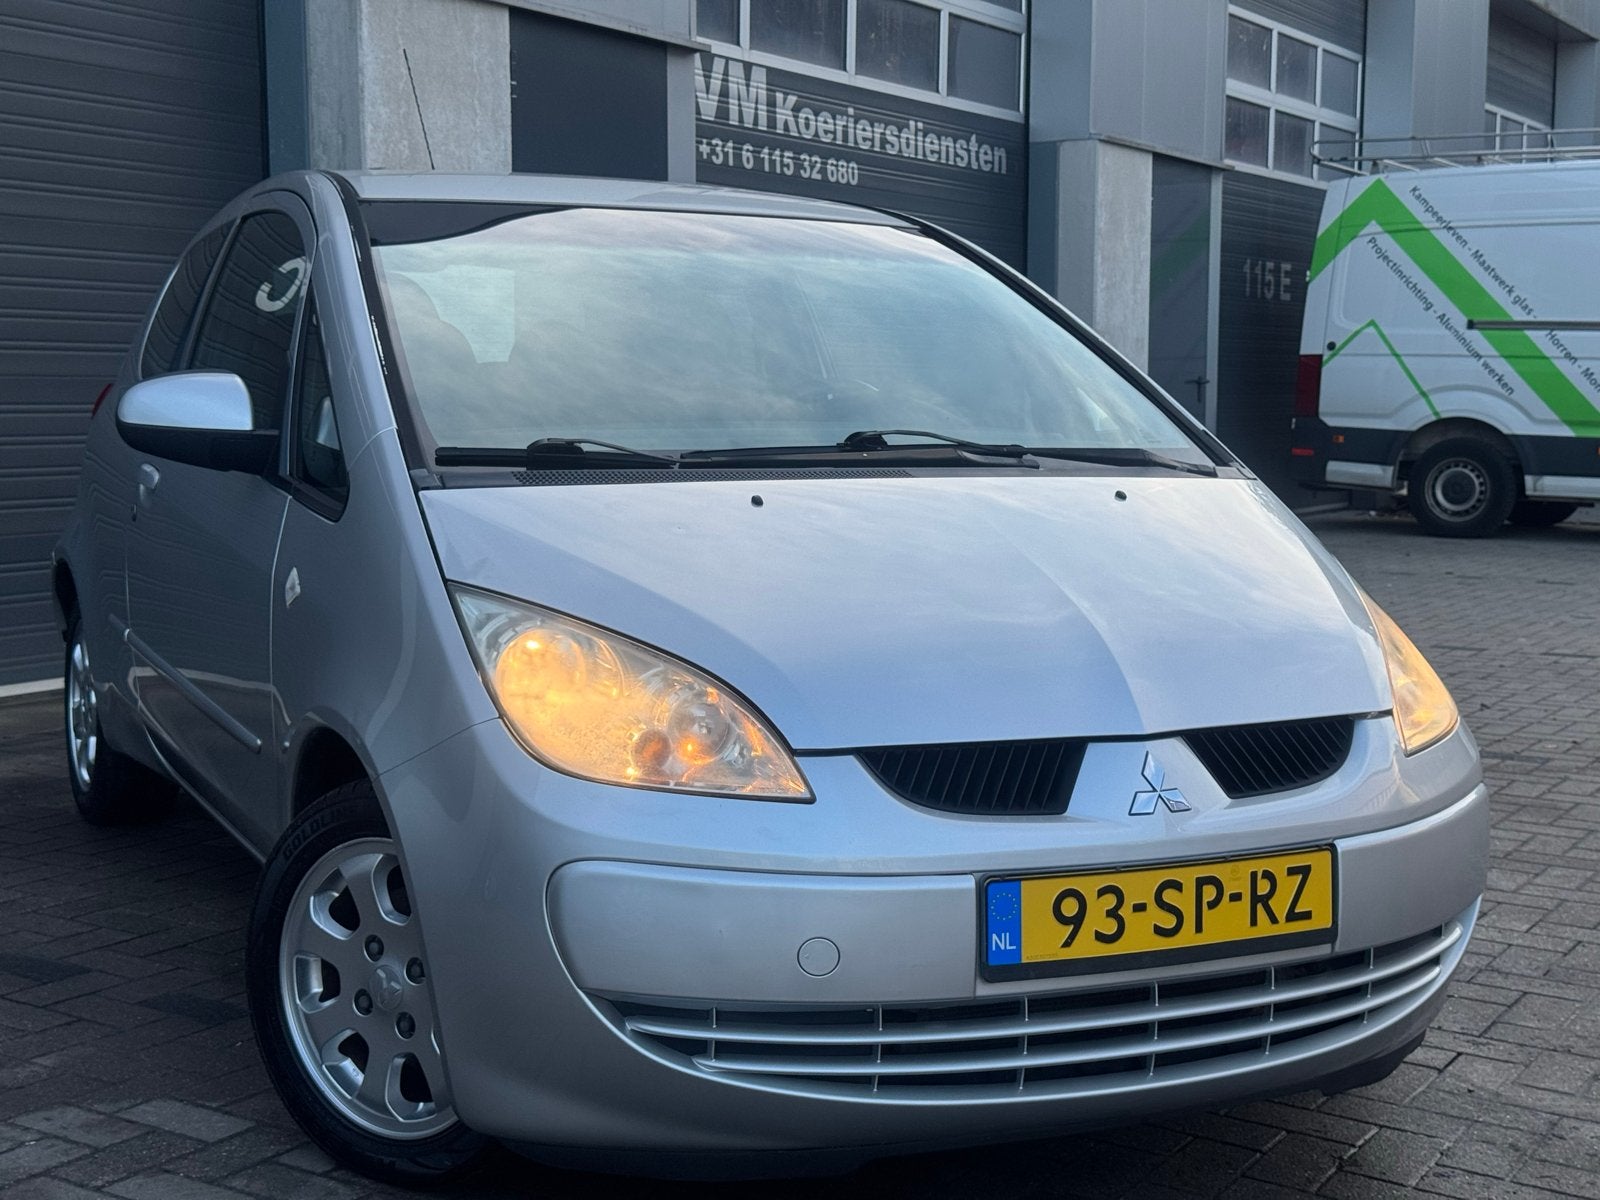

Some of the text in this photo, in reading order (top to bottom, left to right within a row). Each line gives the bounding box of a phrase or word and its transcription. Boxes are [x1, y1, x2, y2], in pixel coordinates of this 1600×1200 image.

[694, 52, 1007, 174] VM Koeriersdiensten
[698, 138, 859, 186] +31 6 115 32 680
[1366, 236, 1434, 313] Projectinrichting
[1436, 312, 1482, 363] Aluminium
[1481, 359, 1515, 397] werken
[1470, 249, 1515, 297] Maatwerk
[1512, 293, 1536, 319] glas
[991, 864, 1313, 951] NL 93-SP-RZ
